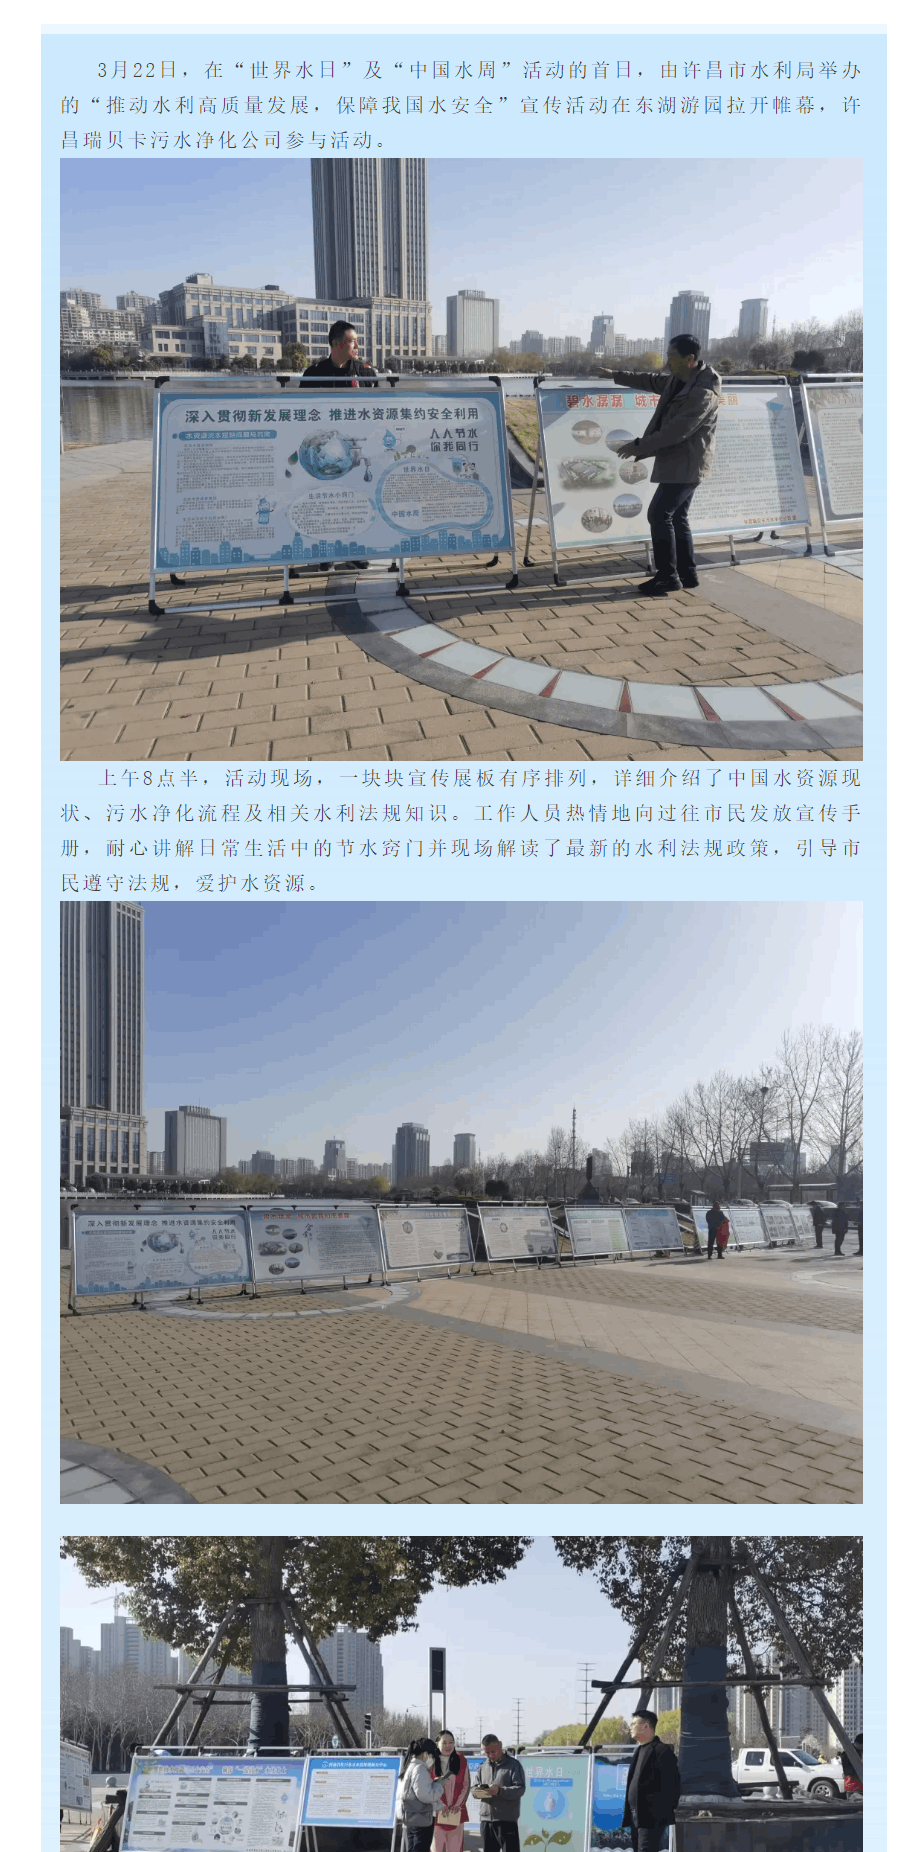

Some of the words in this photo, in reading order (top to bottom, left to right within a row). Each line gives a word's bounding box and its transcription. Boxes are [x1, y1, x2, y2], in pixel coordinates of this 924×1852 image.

[566, 394, 623, 408] 碧水潺潺
[185, 408, 322, 424] 深入贯彻新发展理念
[329, 407, 480, 422] 推进水资源集约安全利用
[430, 428, 479, 440] 人人节水
[430, 440, 479, 453] 你我同行
